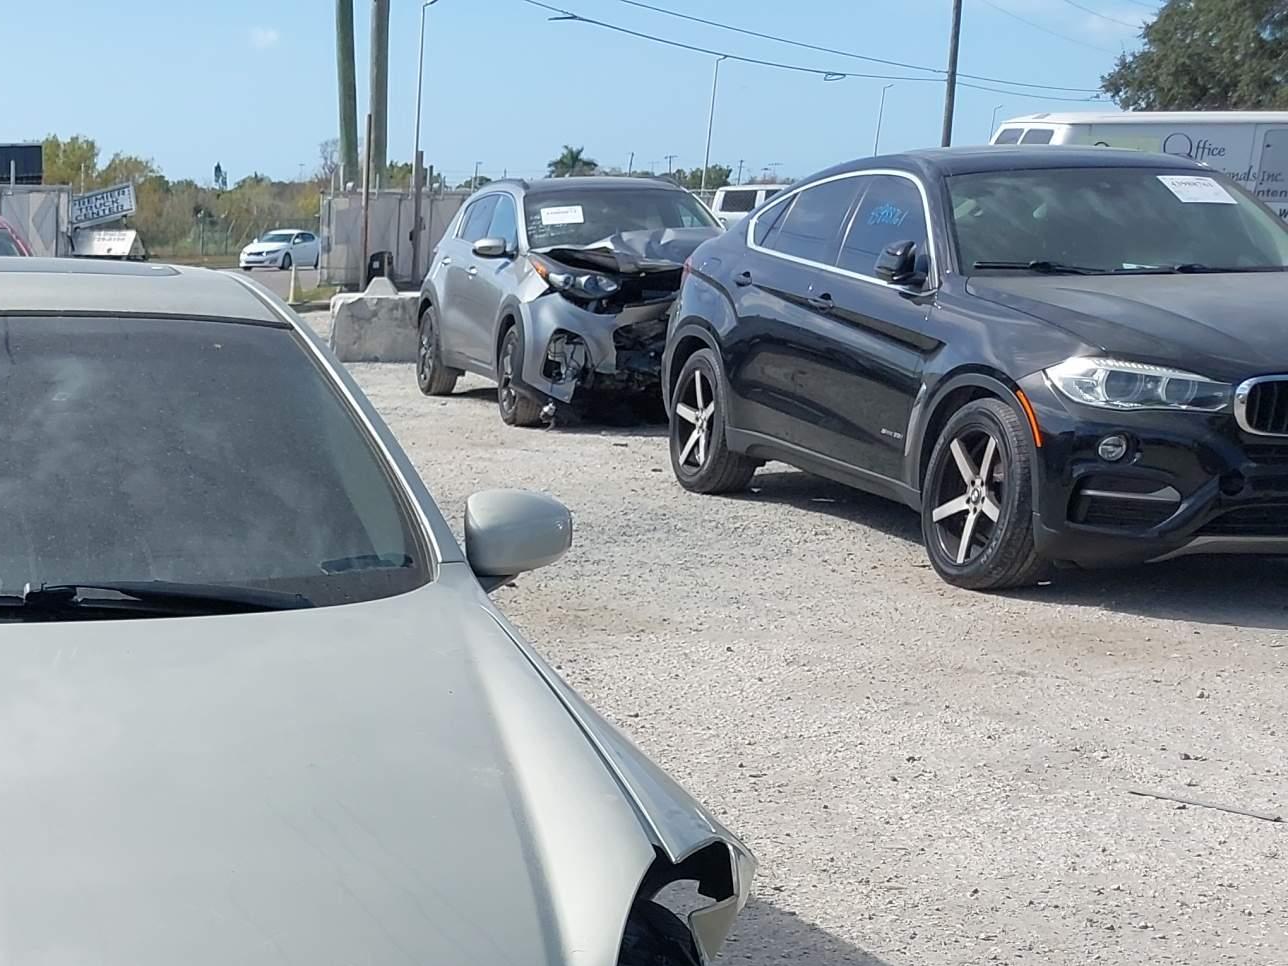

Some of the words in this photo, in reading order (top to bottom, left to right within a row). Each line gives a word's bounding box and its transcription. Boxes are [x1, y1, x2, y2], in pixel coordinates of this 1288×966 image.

[1163, 132, 1226, 160] Office
[73, 190, 126, 207] PREMIER
[79, 199, 119, 214] TRUCK
[75, 204, 124, 221] CENTER
